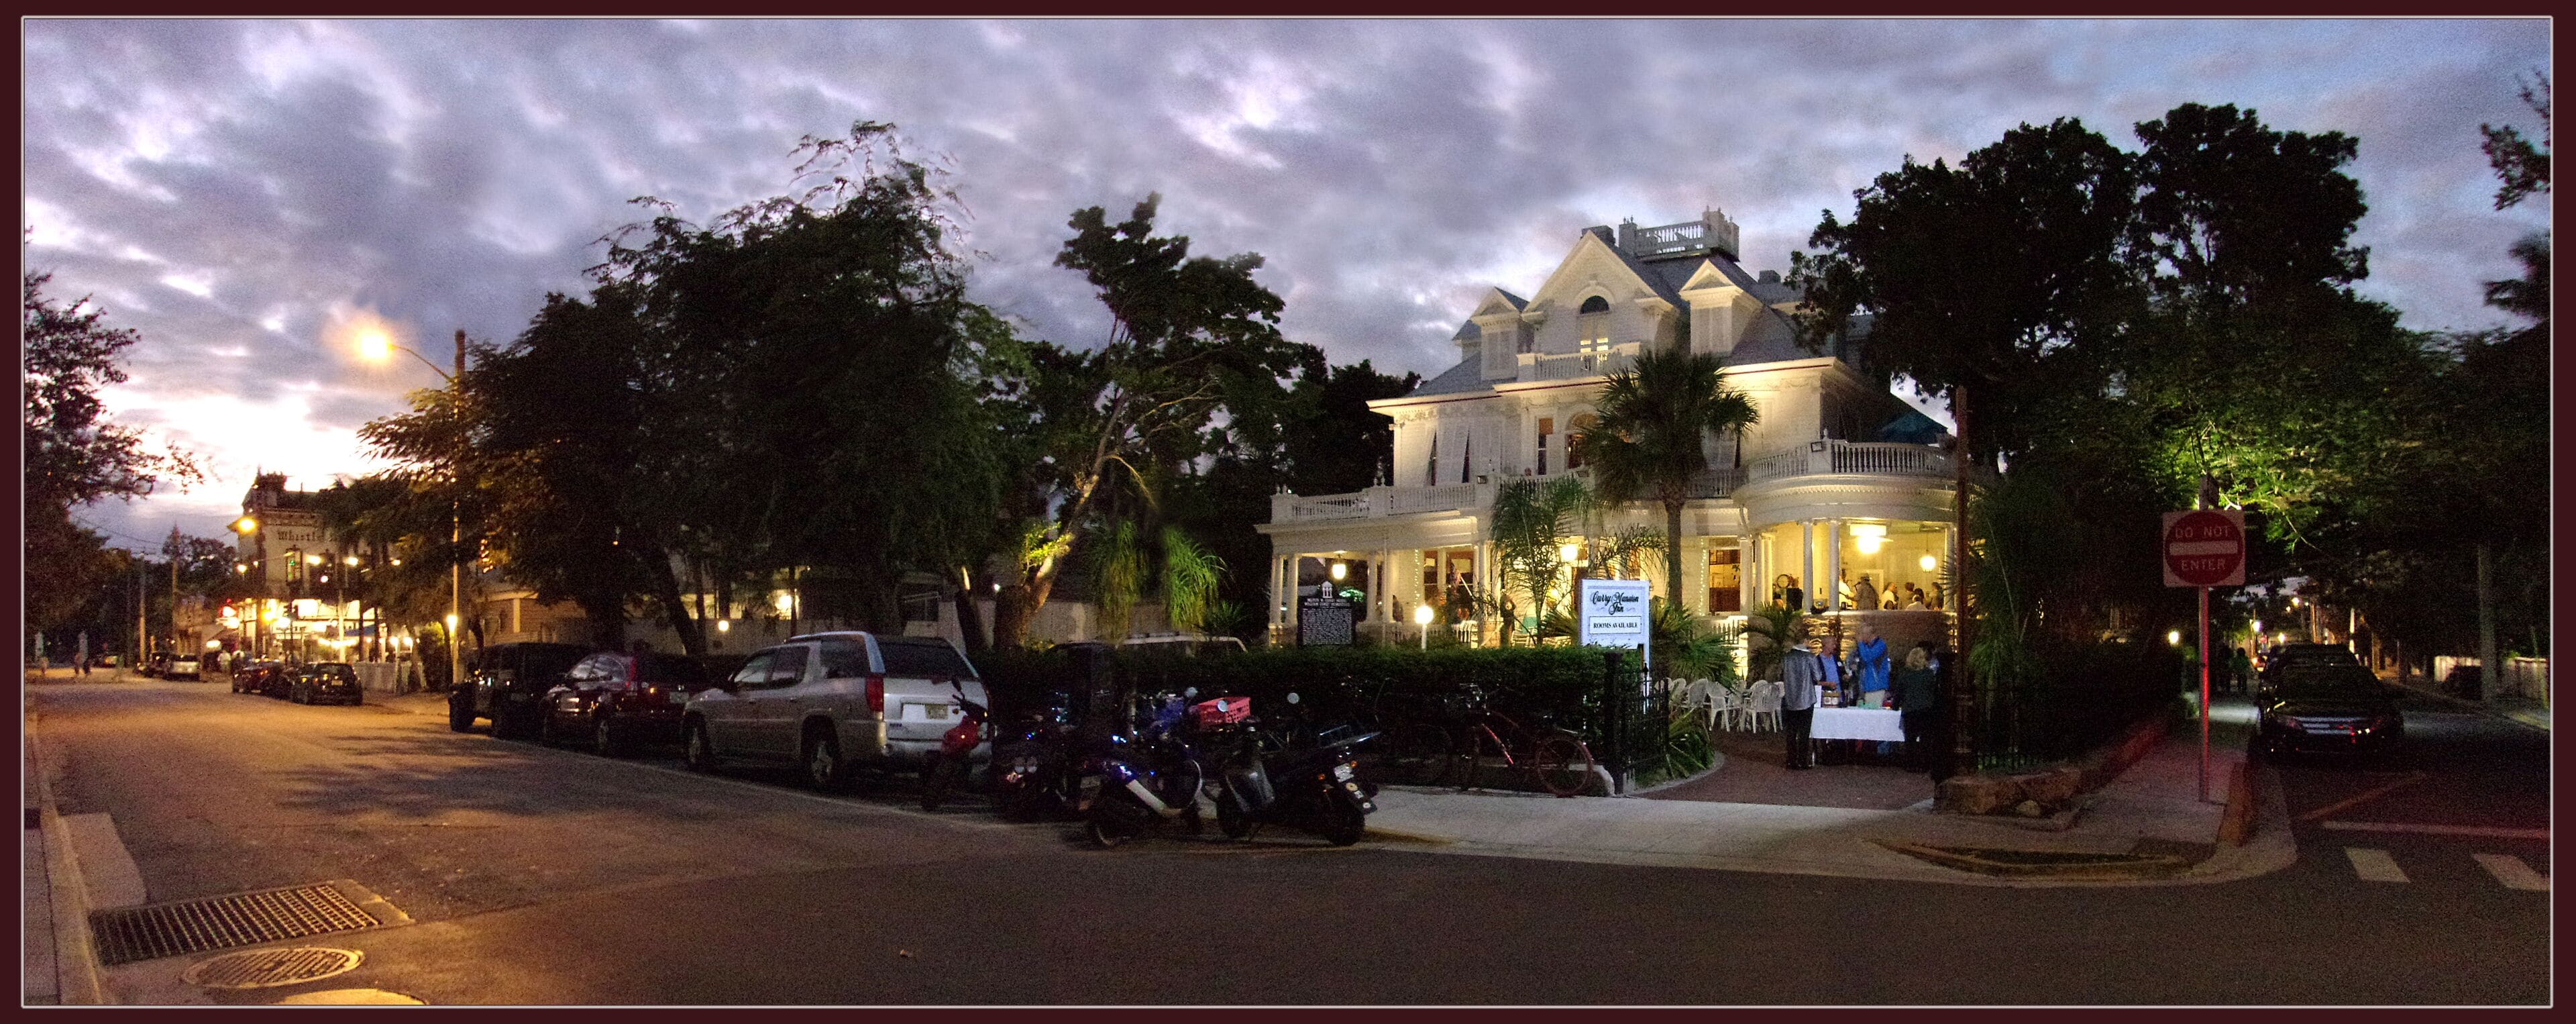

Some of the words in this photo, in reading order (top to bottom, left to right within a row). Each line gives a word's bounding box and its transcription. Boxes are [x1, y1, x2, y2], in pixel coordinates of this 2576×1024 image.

[2176, 526, 2194, 538] DO
[2204, 525, 2230, 537] NOT
[2181, 558, 2226, 570] ENTER
[1591, 591, 1611, 606] Curry
[1611, 592, 1640, 605] Mansion
[1608, 602, 1624, 615] Inn
